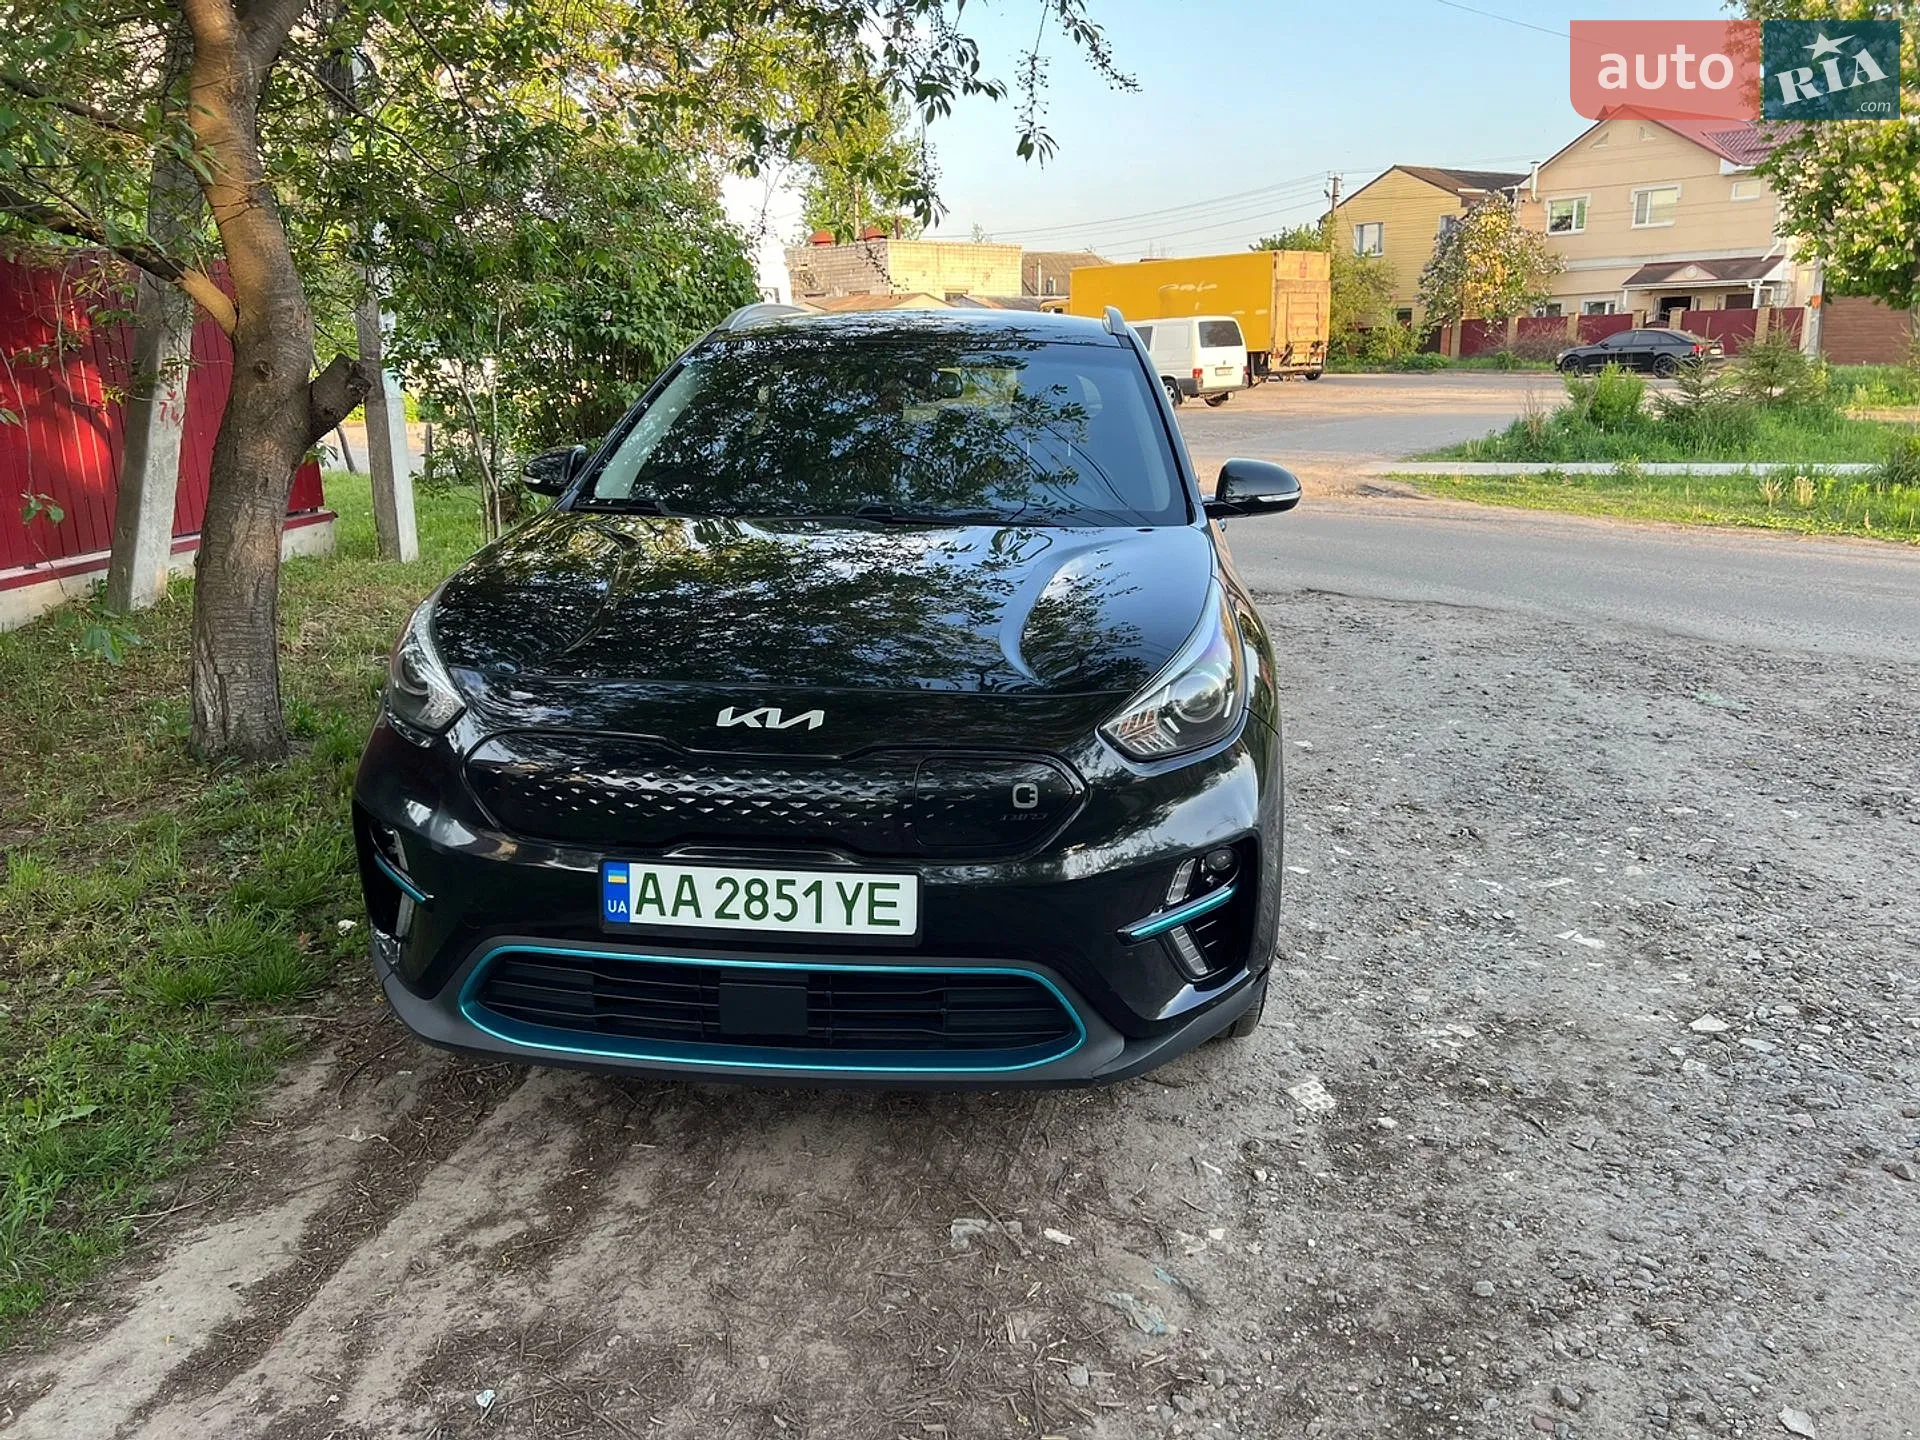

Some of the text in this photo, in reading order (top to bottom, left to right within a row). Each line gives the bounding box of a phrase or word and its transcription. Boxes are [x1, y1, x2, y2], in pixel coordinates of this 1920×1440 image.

[716, 706, 825, 731] KIA
[608, 900, 627, 914] UA
[635, 872, 702, 919] AA
